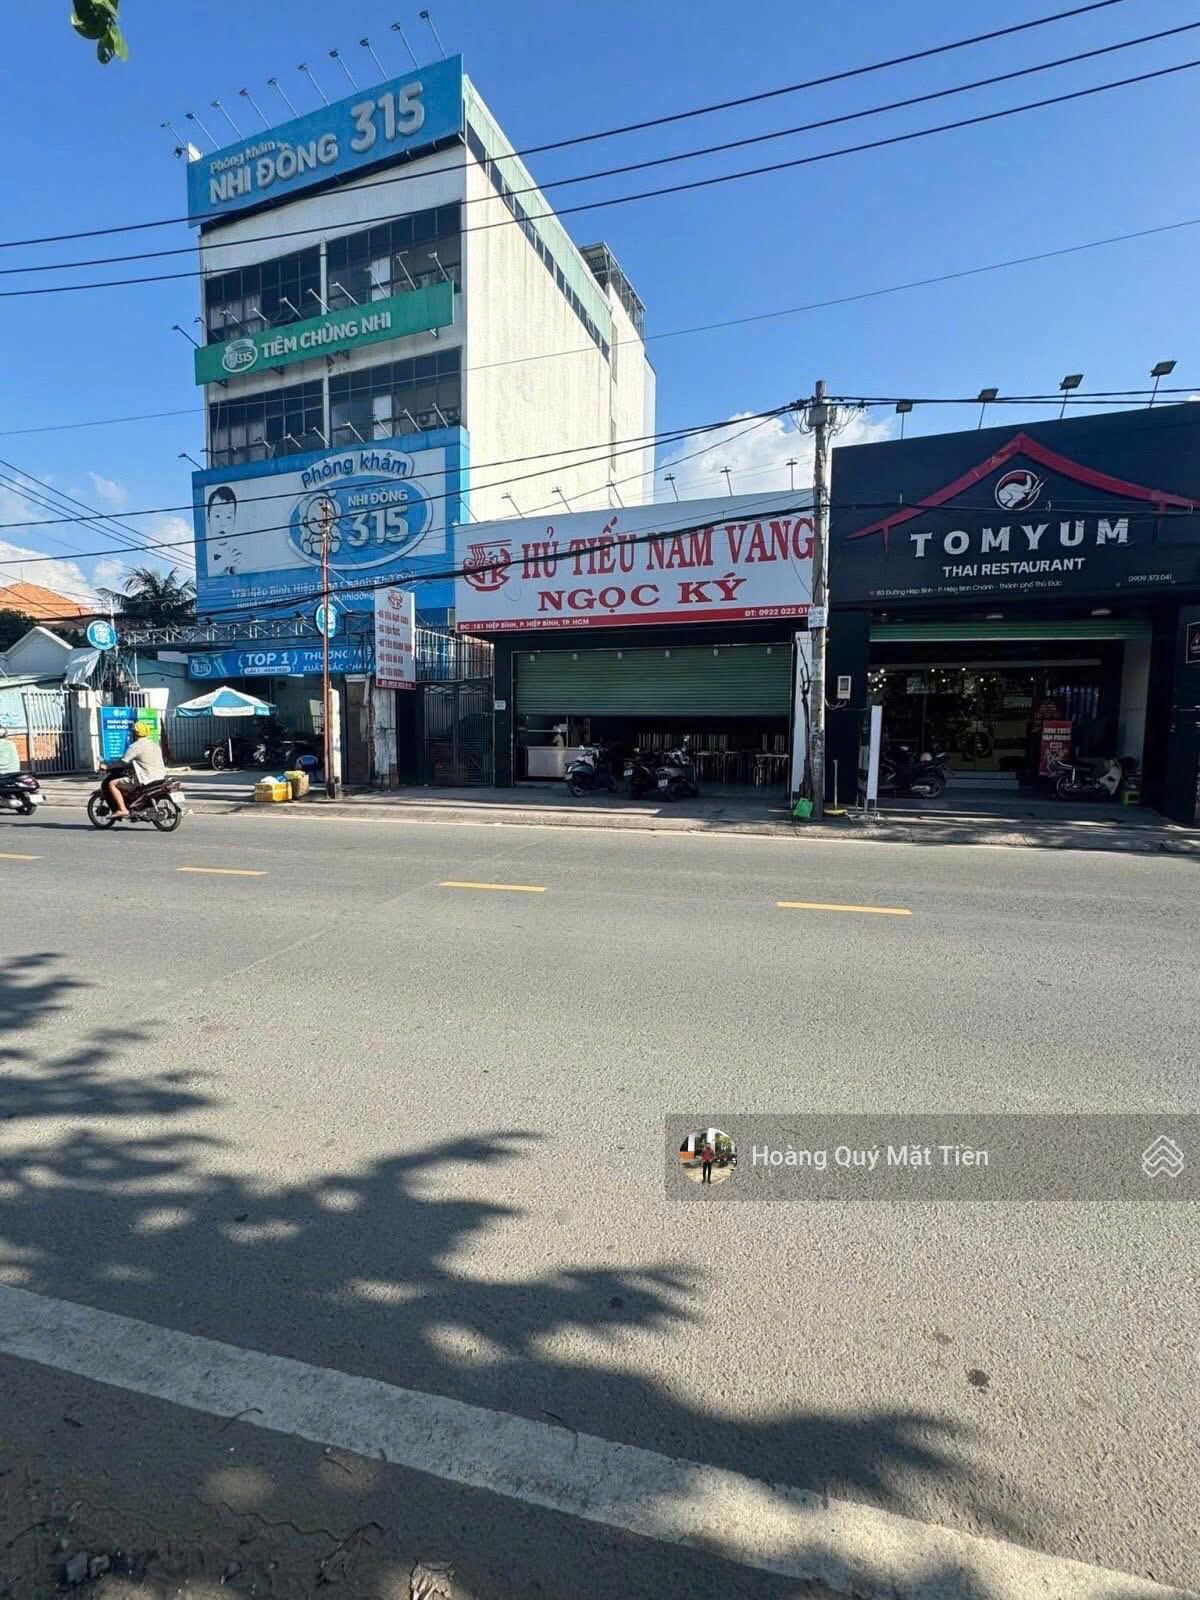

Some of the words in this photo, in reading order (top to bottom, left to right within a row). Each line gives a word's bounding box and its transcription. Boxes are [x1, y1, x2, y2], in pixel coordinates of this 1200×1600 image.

[210, 165, 252, 204] NHI
[256, 133, 339, 188] ĐỒNG
[350, 81, 424, 152] 315
[261, 335, 298, 358] TIÊM
[361, 311, 392, 334] NHI
[300, 457, 354, 488] Phòng
[359, 451, 408, 476] khám
[347, 493, 369, 508] NHI
[370, 488, 409, 505] ĐỒNG
[346, 505, 410, 546] 315
[909, 518, 1129, 558] TOMYUM
[522, 526, 559, 580] HỦ
[571, 516, 635, 576] TIẾU
[646, 528, 714, 571] NAM
[724, 518, 815, 564] VANG
[942, 562, 980, 579] THAI
[981, 557, 1086, 577] RESTAURANT
[538, 583, 660, 613] NGỌC
[677, 571, 747, 604] KÝ
[526, 619, 541, 628] HIỆP
[572, 617, 590, 626] HCM
[744, 609, 757, 617] ĐT:
[759, 607, 779, 617] 0922
[246, 651, 277, 666] TOP
[281, 651, 290, 665] 1
